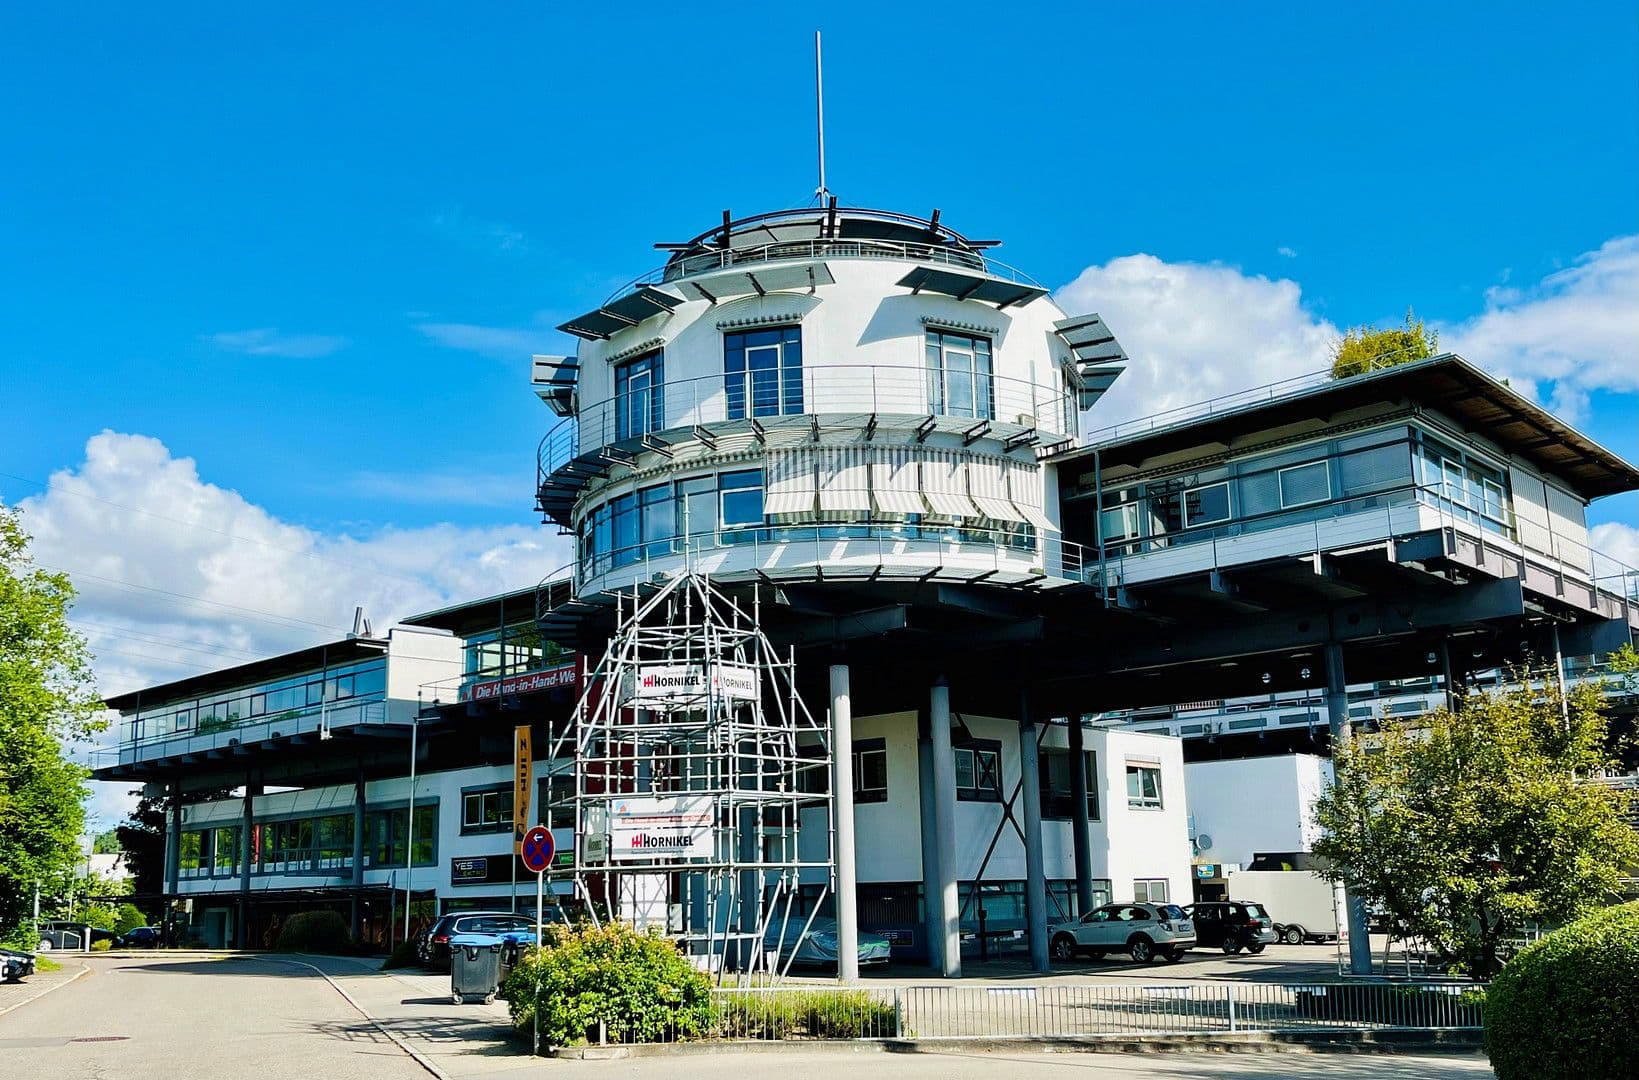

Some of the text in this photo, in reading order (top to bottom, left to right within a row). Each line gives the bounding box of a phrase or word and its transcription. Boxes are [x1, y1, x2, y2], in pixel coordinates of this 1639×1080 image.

[654, 674, 700, 687] HORNIKEL
[721, 677, 752, 691] ORNIKEL
[476, 686, 490, 699] Die
[643, 833, 694, 848] HORNIKEL
[455, 861, 473, 871] YES
